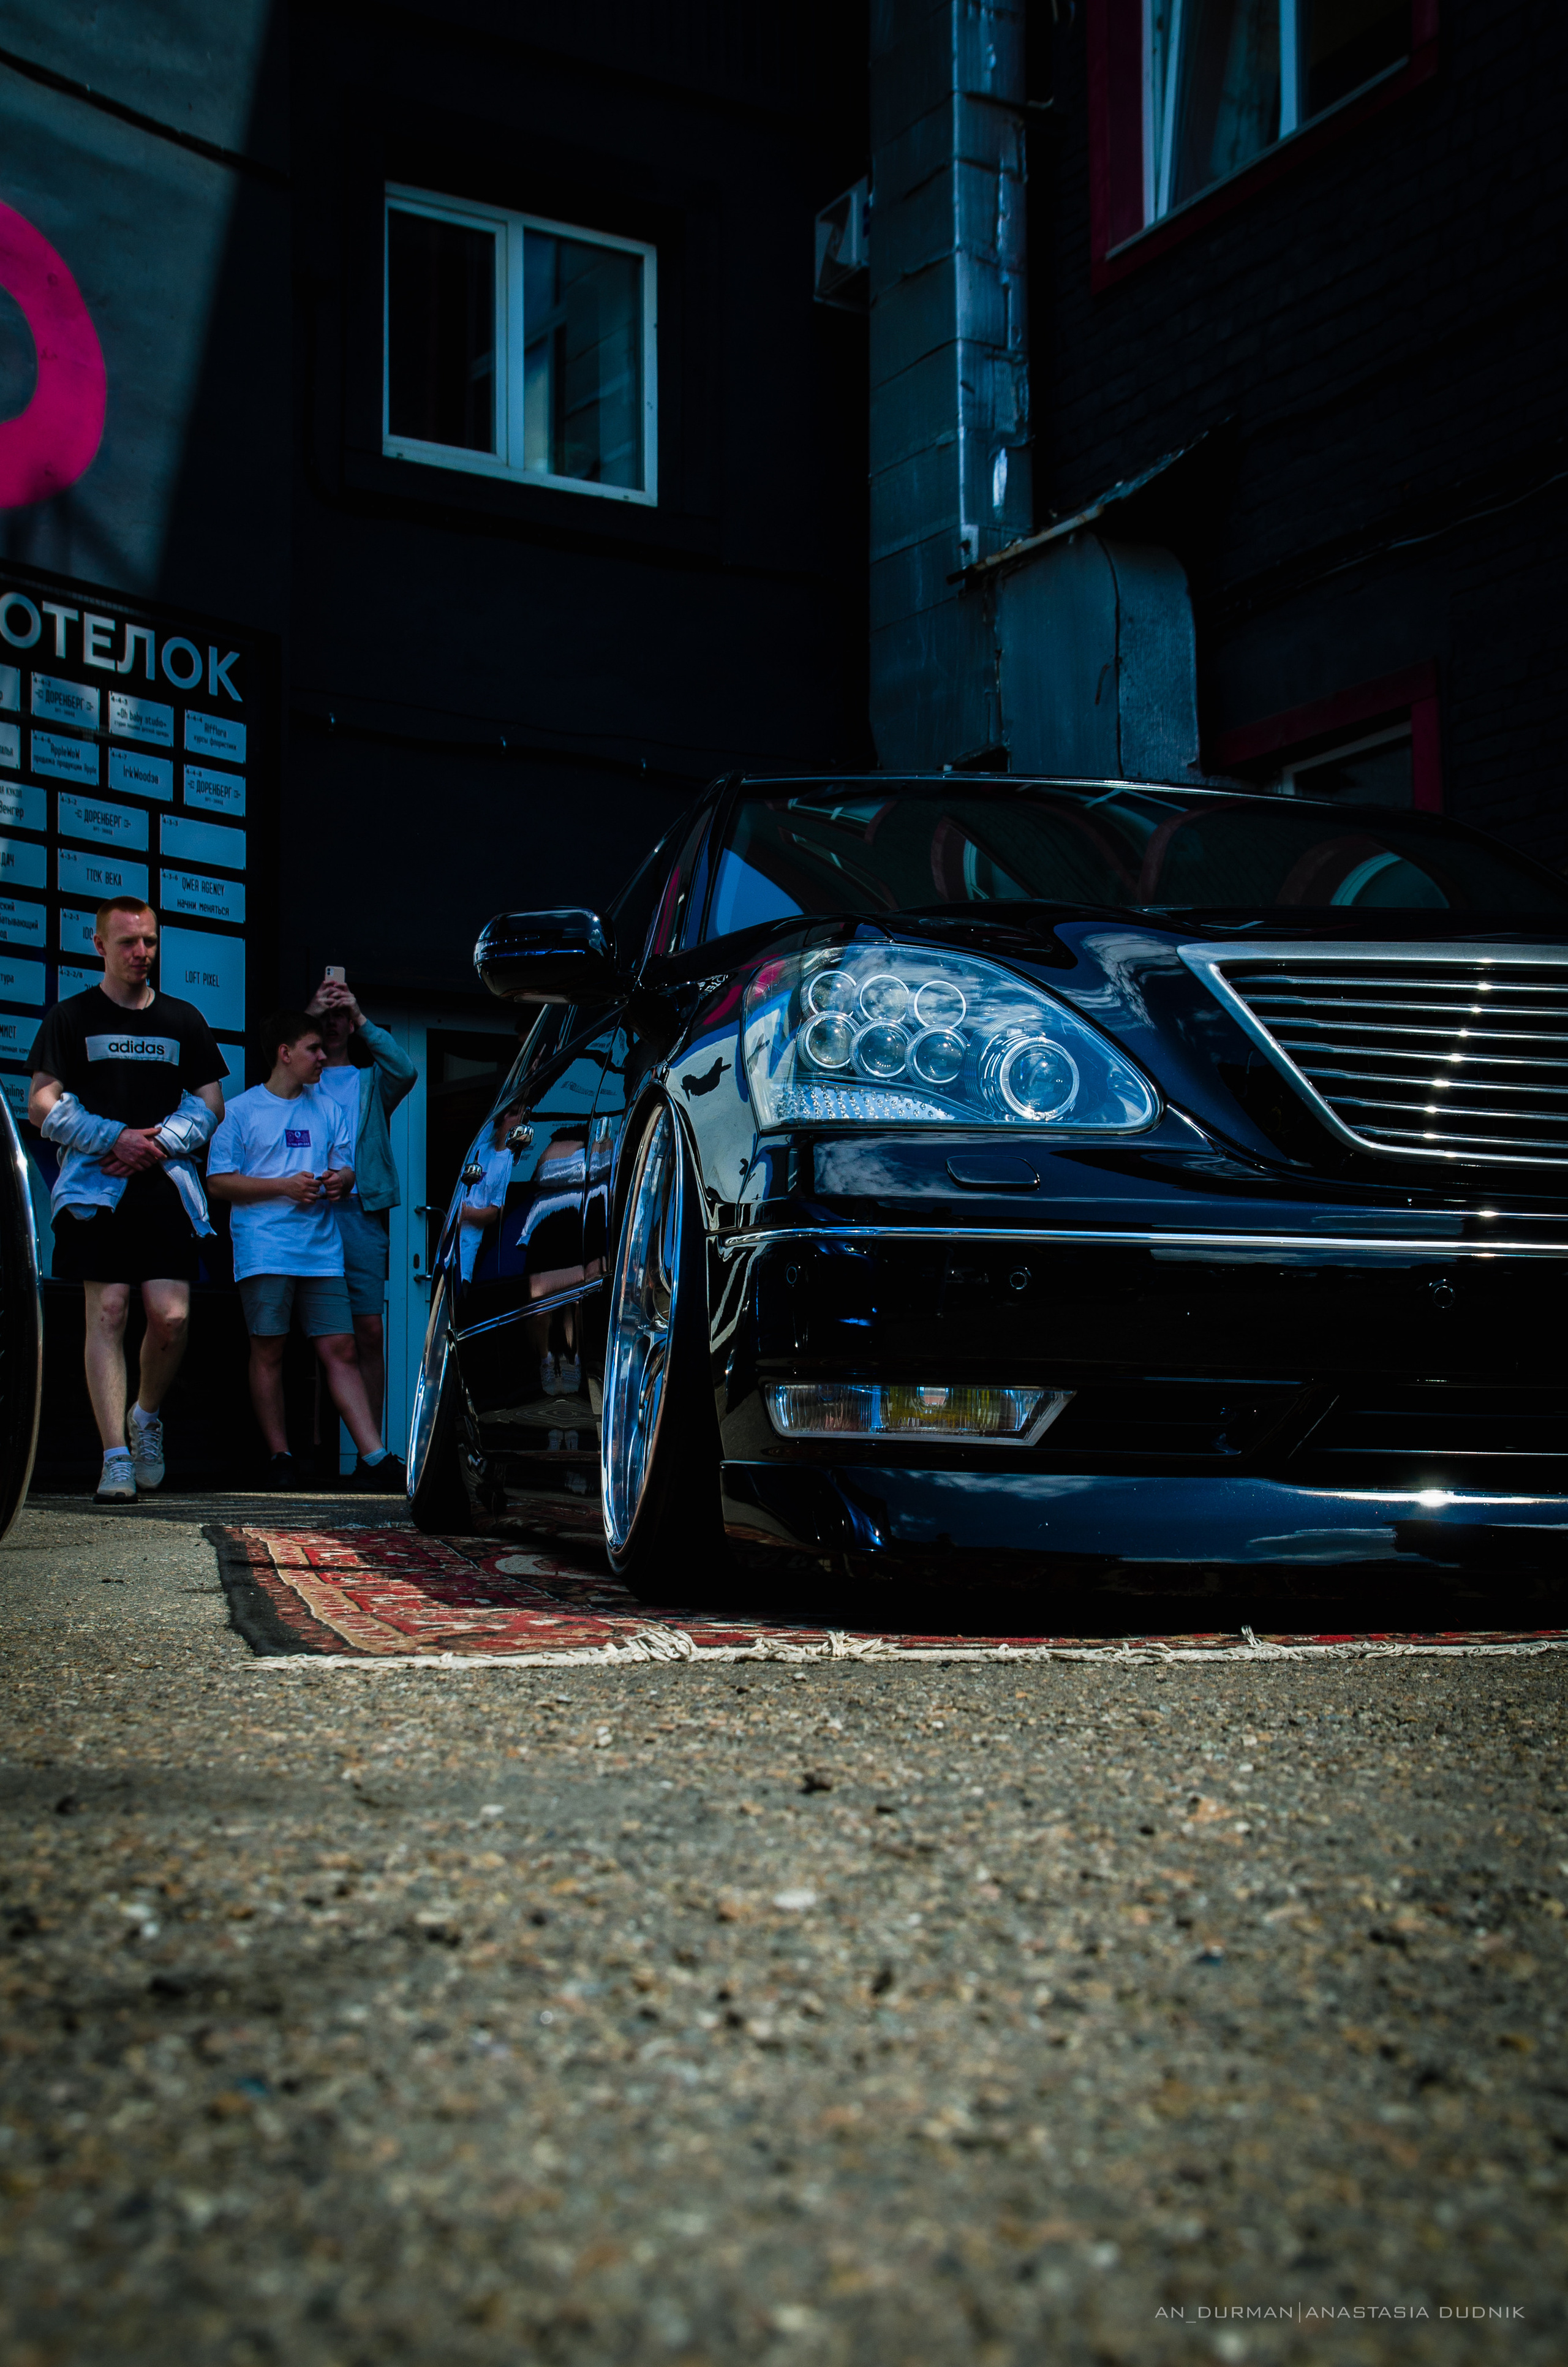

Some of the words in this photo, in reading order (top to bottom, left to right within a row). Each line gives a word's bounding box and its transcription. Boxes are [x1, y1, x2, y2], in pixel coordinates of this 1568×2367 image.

[45, 689, 85, 711] ДОРЕНБЕРГ
[197, 780, 232, 799] ДОРЕНБЕРГ
[84, 809, 123, 828] ДОРЕНБЕРГ
[105, 871, 122, 887] ВЕКА
[162, 872, 179, 881] 4-3-6
[202, 880, 225, 897] AGENCY
[177, 899, 197, 911] начни
[199, 902, 230, 916] меняться
[62, 912, 80, 921] 4-2-3
[185, 970, 200, 984] LOFT
[203, 972, 220, 987] PIXEL
[108, 1040, 165, 1055] adidas
